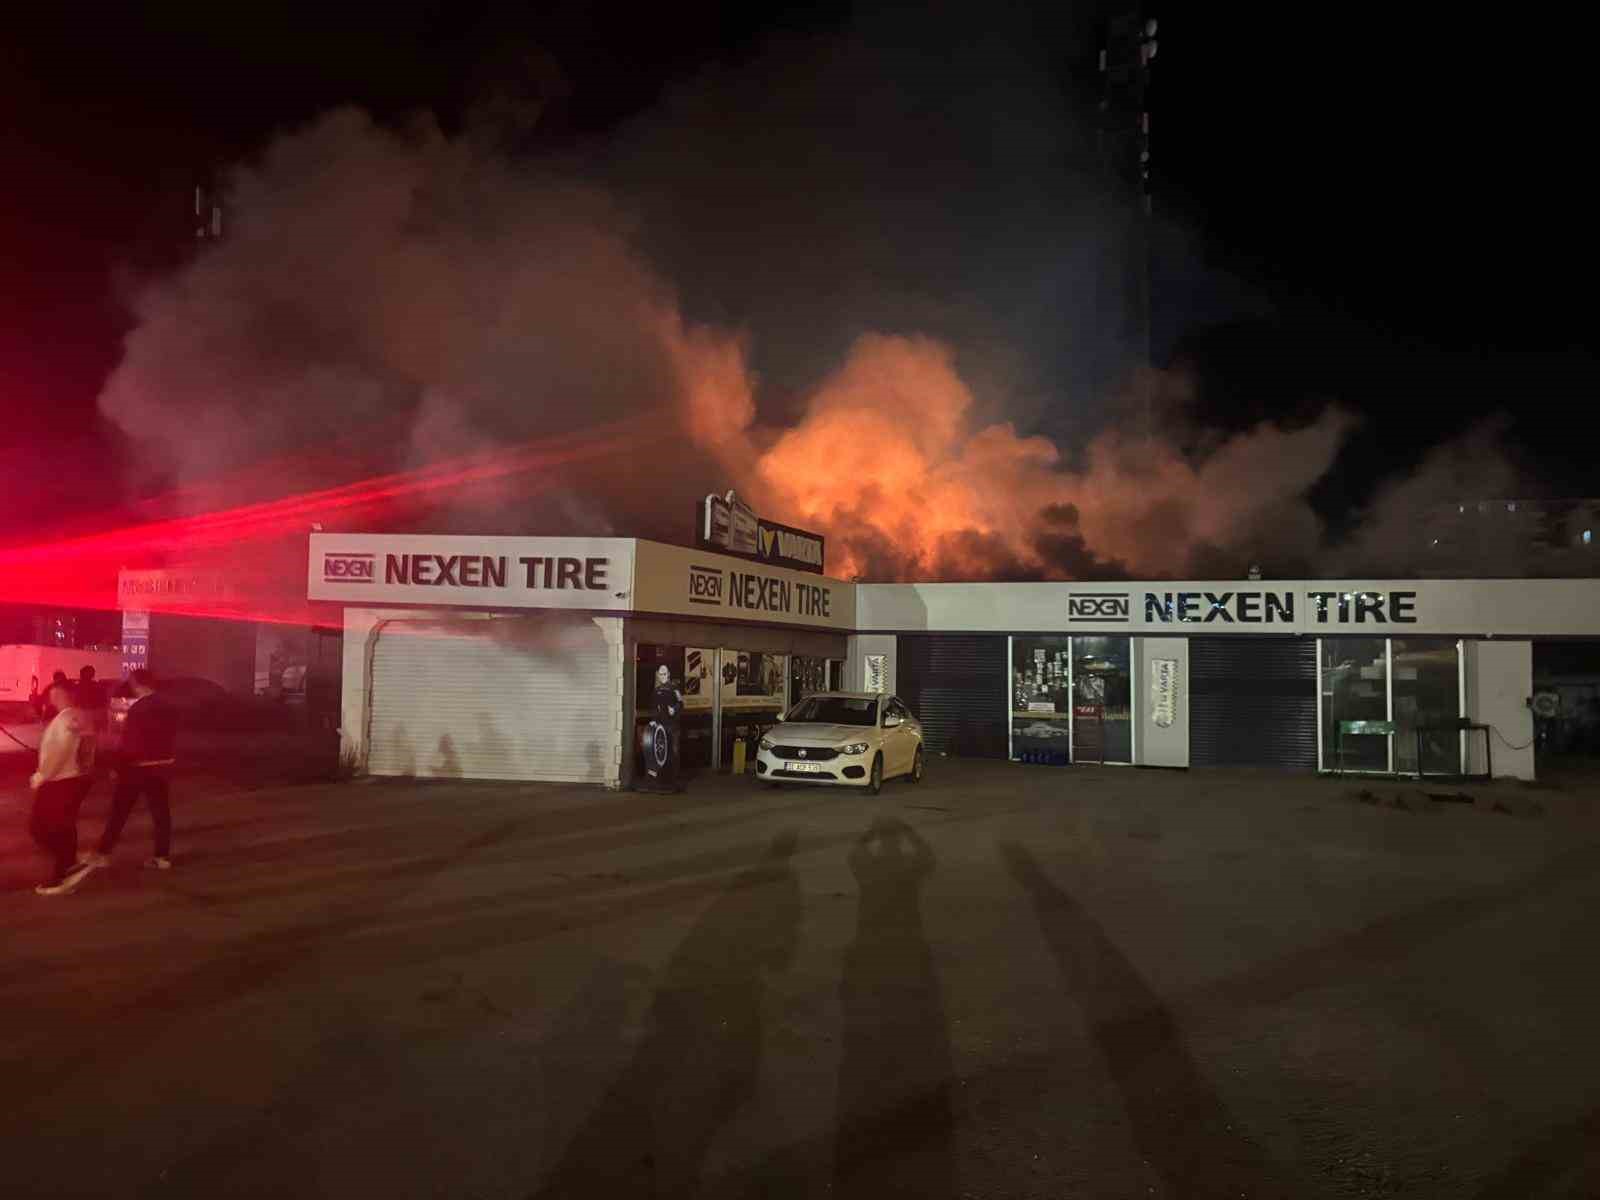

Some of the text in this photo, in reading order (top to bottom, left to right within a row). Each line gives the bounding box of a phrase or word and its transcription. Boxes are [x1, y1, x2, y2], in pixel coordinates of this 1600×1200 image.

[323, 553, 609, 590] NEXEN NEXEN TIRE
[689, 571, 831, 617] NEXEN NEXEN TIRE
[1068, 592, 1417, 623] NEXEN NEXEN TIRE
